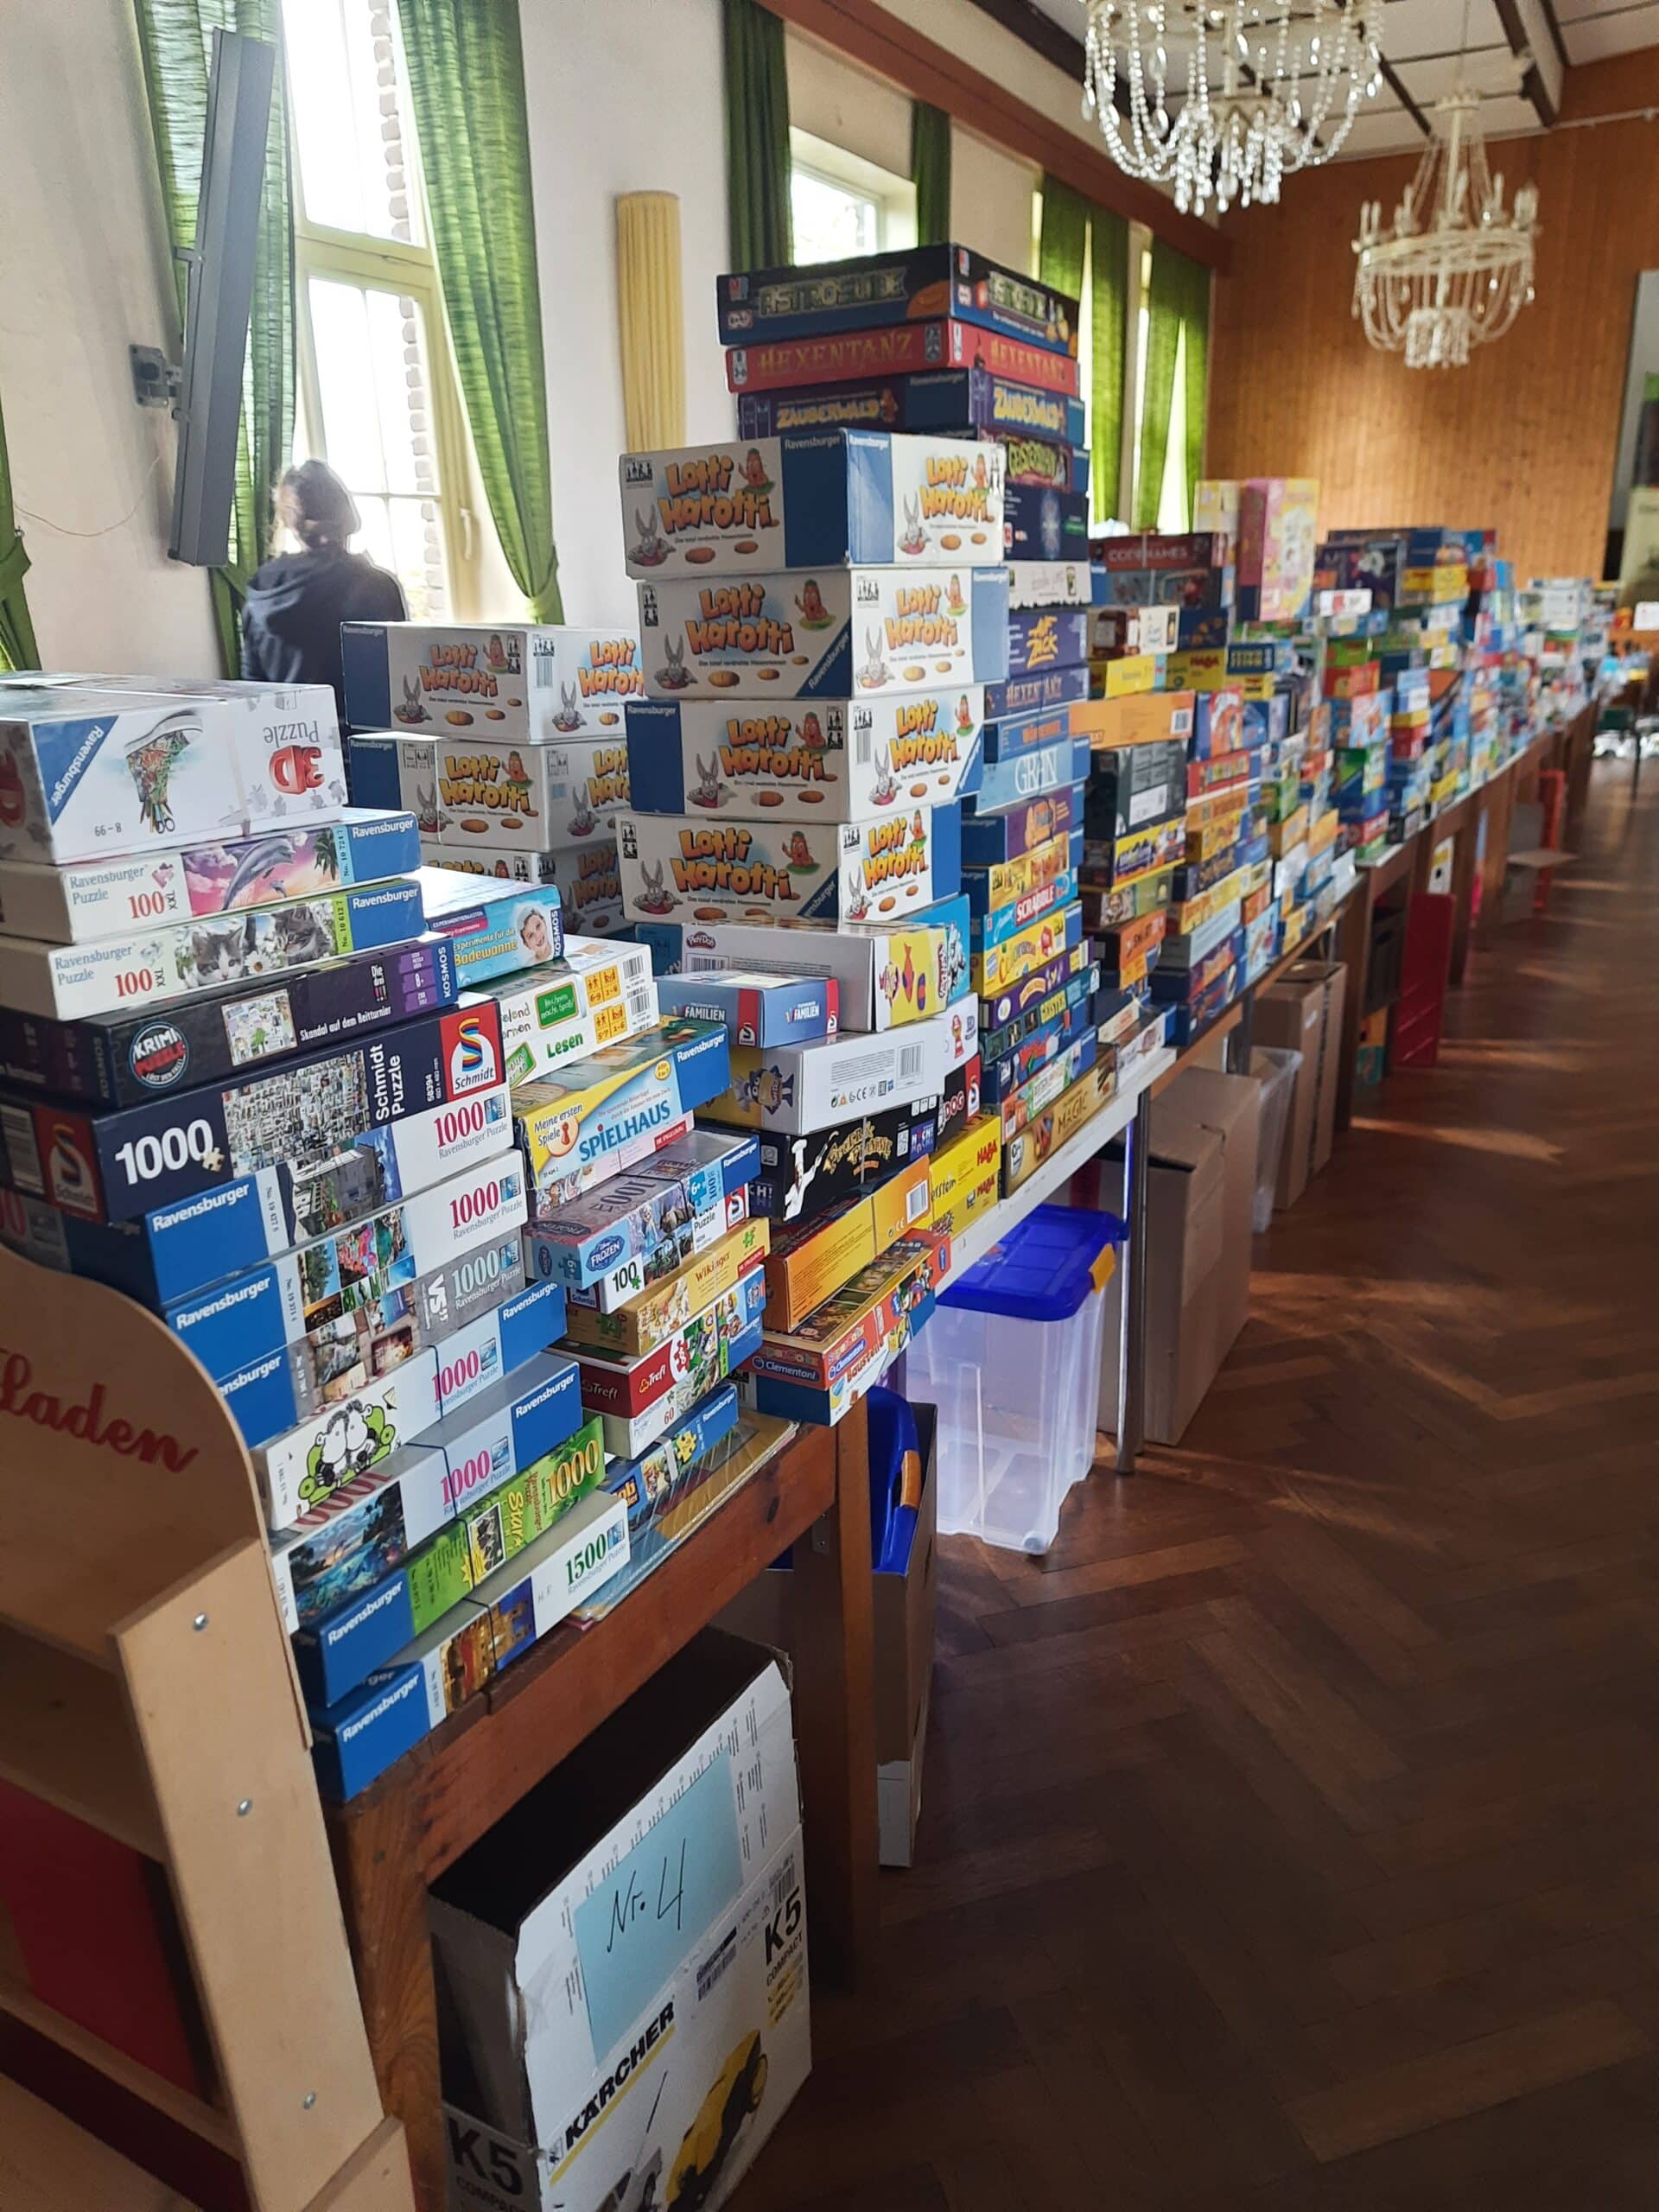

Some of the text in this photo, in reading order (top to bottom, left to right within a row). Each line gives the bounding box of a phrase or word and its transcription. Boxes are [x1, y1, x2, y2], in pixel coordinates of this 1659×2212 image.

[785, 435, 842, 449] Ravensburger
[665, 454, 734, 497] Lotti
[926, 455, 968, 487] Lotti
[658, 489, 771, 535] Karotti
[919, 486, 988, 522] Karotti
[699, 582, 766, 620] Lotti
[895, 585, 942, 617] Lotti
[686, 615, 795, 655] Karotti
[884, 617, 959, 652] Karotti
[431, 644, 478, 668] Lotti
[589, 639, 636, 668] Lotti
[808, 632, 851, 690] Ravensburger
[419, 666, 499, 697] Karotti
[578, 667, 645, 698] Karott
[264, 721, 321, 744] Puzzle
[726, 715, 793, 747] Lotti
[895, 700, 938, 735] Lotti
[52, 725, 103, 808] Ravensburger
[445, 755, 500, 779] Lotti
[719, 745, 826, 782] Karotti
[889, 734, 961, 774] Karotti
[439, 779, 531, 815] Karotti
[353, 819, 414, 839] Ravensburger
[678, 828, 753, 862] Lotti
[868, 817, 908, 855] Lotti
[69, 866, 145, 889] Ravensburger
[670, 858, 793, 901] Karotti
[864, 848, 926, 891] Karotti
[72, 888, 109, 906] Puzzle
[128, 892, 165, 919] 100
[353, 887, 418, 910] Ravensburger
[1017, 885, 1055, 923] SCRABBLE
[550, 910, 560, 957] KOSMOS
[54, 946, 132, 971] Ravensburger
[454, 939, 518, 967] Badewanne
[57, 967, 95, 986] Puzzle
[114, 968, 152, 998] 100
[438, 946, 452, 999] KOSMOS
[684, 1005, 726, 1022] FAMILIEN
[793, 1005, 820, 1021] FAMILIEN
[134, 1027, 178, 1061] KRIMI
[300, 1023, 328, 1042] Skandal
[329, 1019, 341, 1035] auf
[546, 1033, 583, 1058] Lesen
[677, 1033, 725, 1063] Ravensburger
[370, 1043, 389, 1122] Schmidt
[389, 1055, 405, 1116] Puzzle
[454, 1066, 496, 1090] Schmidt
[534, 1116, 558, 1134] Meine
[559, 1103, 583, 1123] ersten
[944, 1090, 965, 1121] DOG
[434, 1101, 484, 1148] 1000
[538, 1129, 561, 1147] Spiele
[579, 1099, 671, 1162] SPIELHAUS
[115, 1119, 214, 1185] 1000
[977, 1140, 997, 1166] HABA
[152, 1182, 250, 1233] Ravensburger
[449, 1181, 499, 1230] 1000
[694, 1213, 716, 1231] Puzzle
[591, 1242, 620, 1267] FROZEN
[452, 1249, 499, 1299] 1000
[613, 1262, 638, 1292] 100
[175, 1275, 271, 1331] Ravensburger
[766, 1361, 817, 1380] Clementoni
[836, 1341, 865, 1372] Clementoni
[219, 1354, 282, 1397] ensburger
[432, 1351, 479, 1404] 1000
[592, 1382, 619, 1398] Trefl
[647, 1363, 666, 1388] Trefl
[516, 1373, 575, 1418] Ravensburger
[664, 1408, 675, 1425] 60
[441, 1450, 490, 1506] 1000
[547, 1440, 599, 1509] 1000
[566, 1533, 607, 1586] 1500
[328, 1581, 404, 1645] Ravensburger
[342, 1675, 418, 1743] Ravensburger
[607, 1838, 687, 1954] Nr. 4
[766, 1929, 804, 1987] COMPACT
[565, 2000, 676, 2152] KÄRCHER
